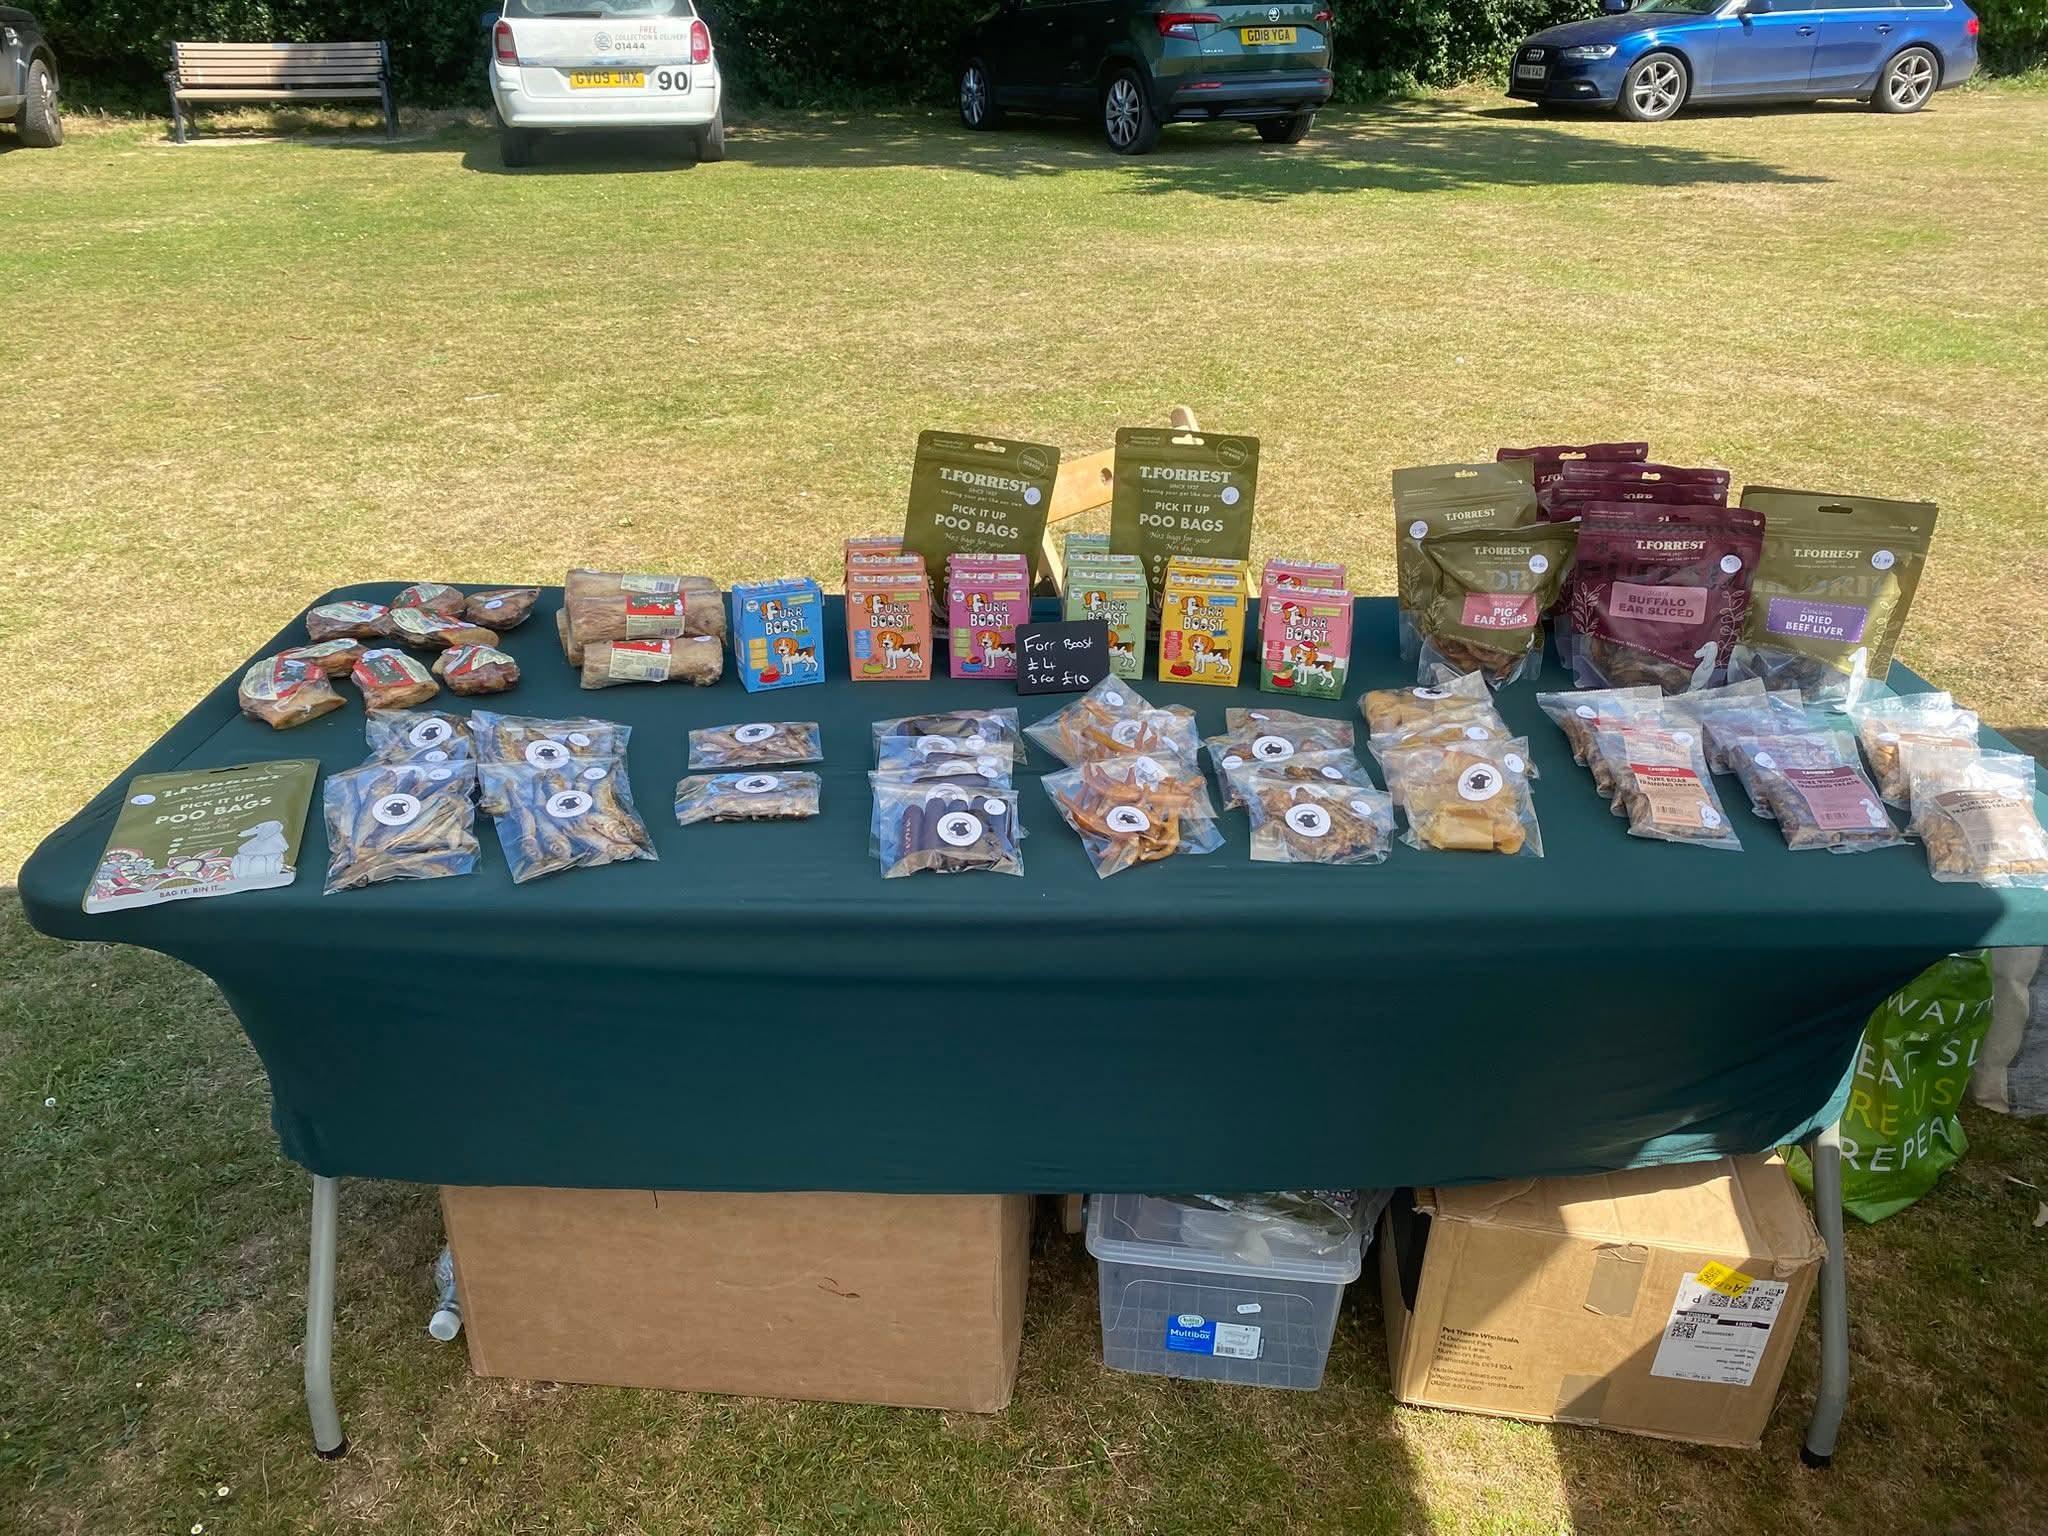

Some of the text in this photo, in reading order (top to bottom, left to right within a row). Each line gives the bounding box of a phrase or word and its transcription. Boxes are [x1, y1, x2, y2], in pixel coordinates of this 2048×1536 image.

[614, 33, 652, 41] COLLECTION
[660, 32, 688, 40] DELIVERY
[640, 25, 657, 33] FREE
[1247, 29, 1290, 42] GD18 YGA
[614, 42, 646, 50] 01444
[576, 71, 610, 85] GV09
[657, 71, 688, 91] 90
[939, 467, 1030, 493] T.FORREST
[1140, 466, 1231, 483] T.FORREST
[952, 504, 1007, 520] PICK IT UP
[1155, 501, 1210, 514] PICK IT UP
[1445, 509, 1495, 521] T.FORREST
[934, 513, 1019, 540] POO BAGS
[1139, 513, 1224, 532] POO BAGS
[1473, 546, 1532, 556] T.FORREST
[1635, 540, 1706, 550] T.FORREST
[1793, 548, 1862, 559] T.FORREST
[872, 595, 909, 613] FURR
[972, 594, 1009, 613] FURR
[1091, 591, 1127, 610] FURR
[1187, 597, 1224, 616] FURR
[1628, 594, 1687, 607] BUFFALO
[766, 601, 804, 620] FURR
[1619, 602, 1695, 618] EAR SLICED
[870, 613, 911, 628] BOOST
[969, 613, 1010, 627] BOOST
[1183, 616, 1225, 631] BOOST
[1290, 611, 1327, 628] FURR
[1474, 614, 1528, 626] EAR STRIPS
[1799, 613, 1833, 625] DRIED
[765, 618, 805, 636] BOOST
[1785, 621, 1844, 636] BEEF LIVER
[1063, 635, 1093, 650] Boost
[1286, 627, 1328, 643] BOOST
[1028, 674, 1037, 684] 3
[1061, 671, 1090, 686] £10
[180, 793, 255, 811] PICK IT UP
[155, 810, 206, 825] POO
[214, 797, 272, 815] BAGS
[1692, 1294, 1702, 1304] P
[1170, 1328, 1211, 1341] Multibox
[1442, 1326, 1455, 1334] Pet
[1456, 1329, 1479, 1338] Treats
